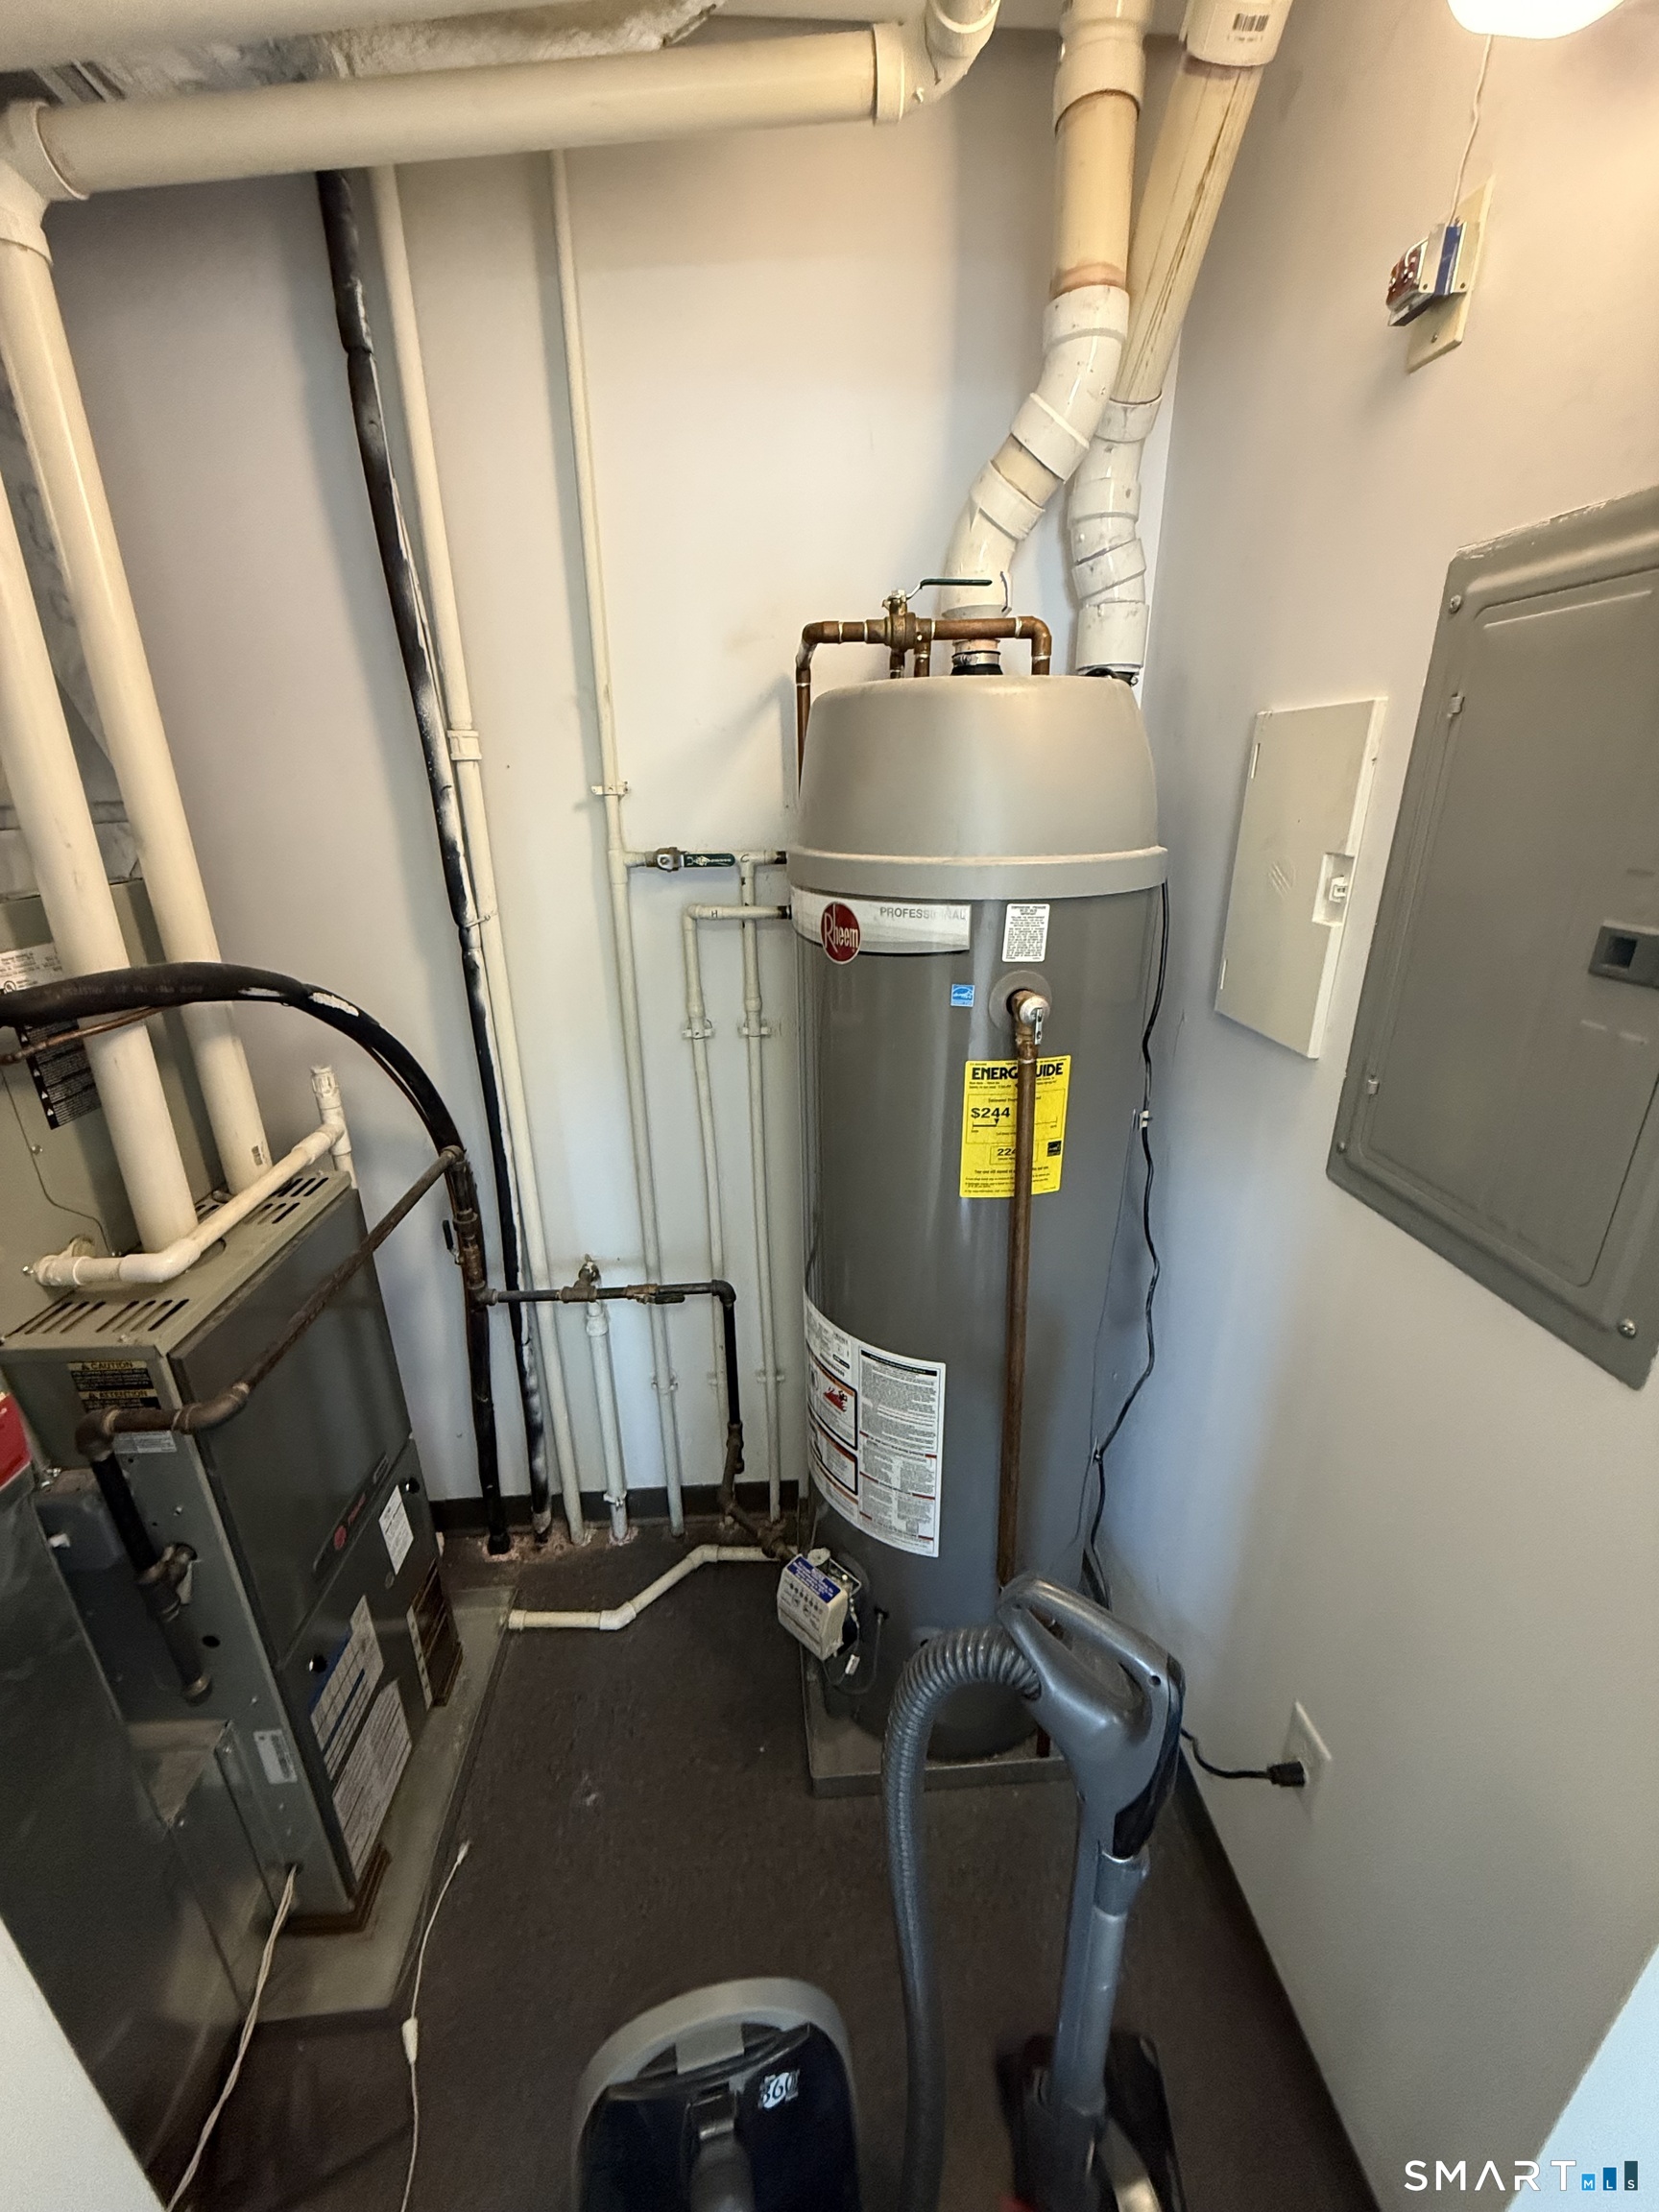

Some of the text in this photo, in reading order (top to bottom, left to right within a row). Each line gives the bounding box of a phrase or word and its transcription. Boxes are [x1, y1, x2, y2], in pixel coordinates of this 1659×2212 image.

[710, 910, 718, 919] H
[824, 904, 859, 953] Rheem
[972, 1062, 1064, 1081] ENERGUIDE
[971, 1107, 1011, 1118] $244
[90, 1361, 133, 1370] CAUTION
